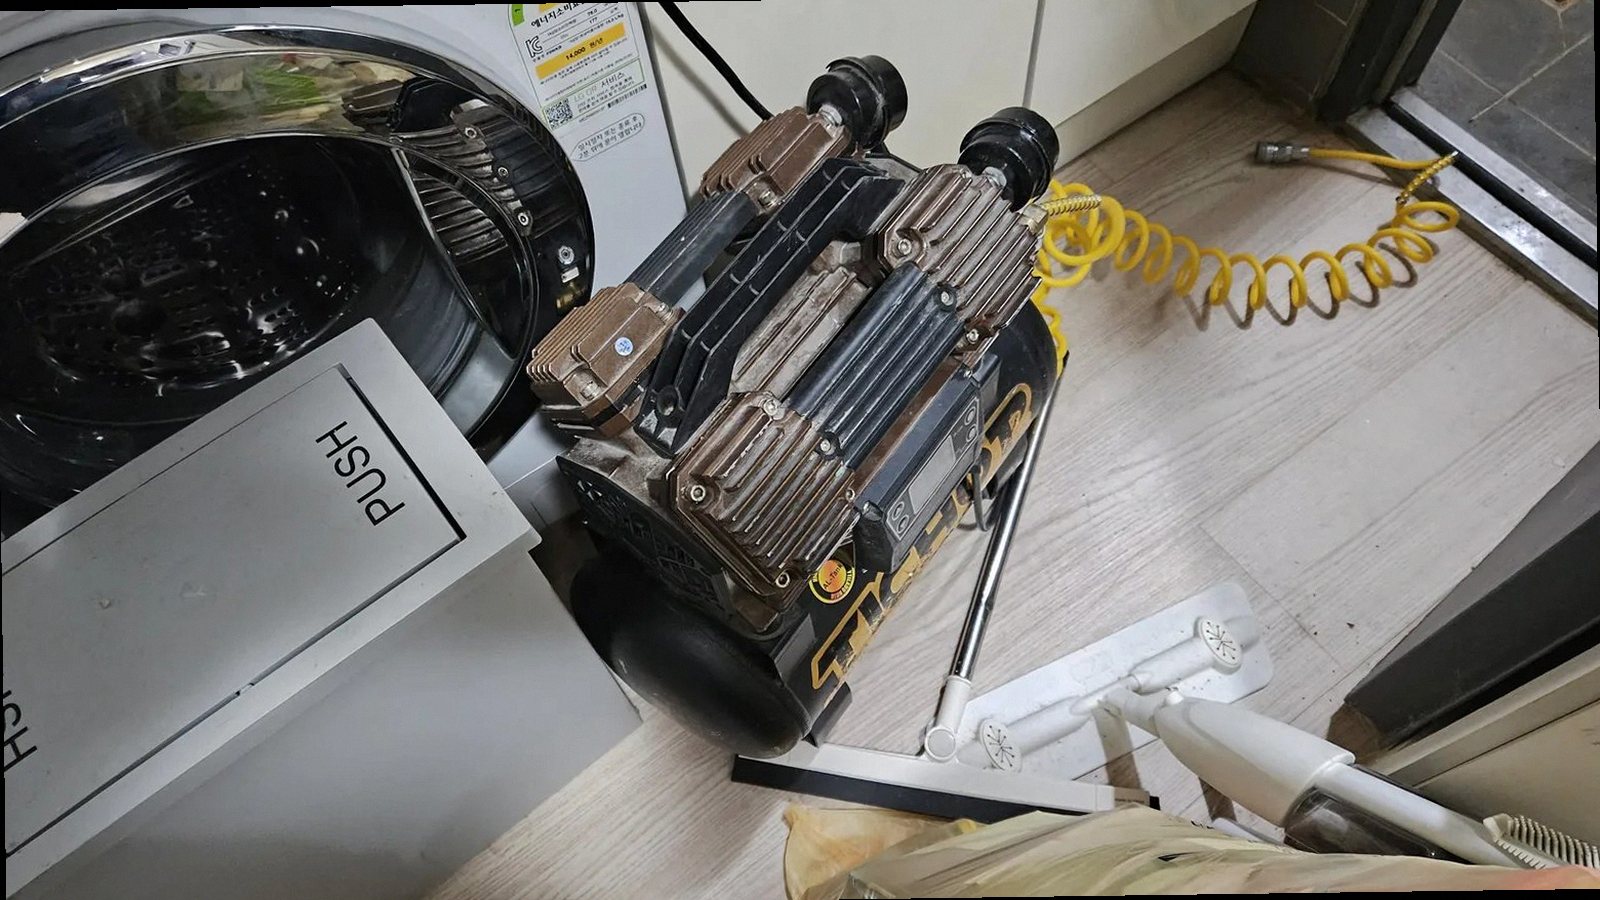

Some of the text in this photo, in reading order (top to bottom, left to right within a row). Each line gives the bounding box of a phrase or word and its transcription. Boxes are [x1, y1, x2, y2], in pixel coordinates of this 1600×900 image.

[565, 46, 586, 60] 14,000
[600, 72, 625, 88] 서비스
[315, 421, 406, 526] PUSH
[3, 690, 38, 773] SH
